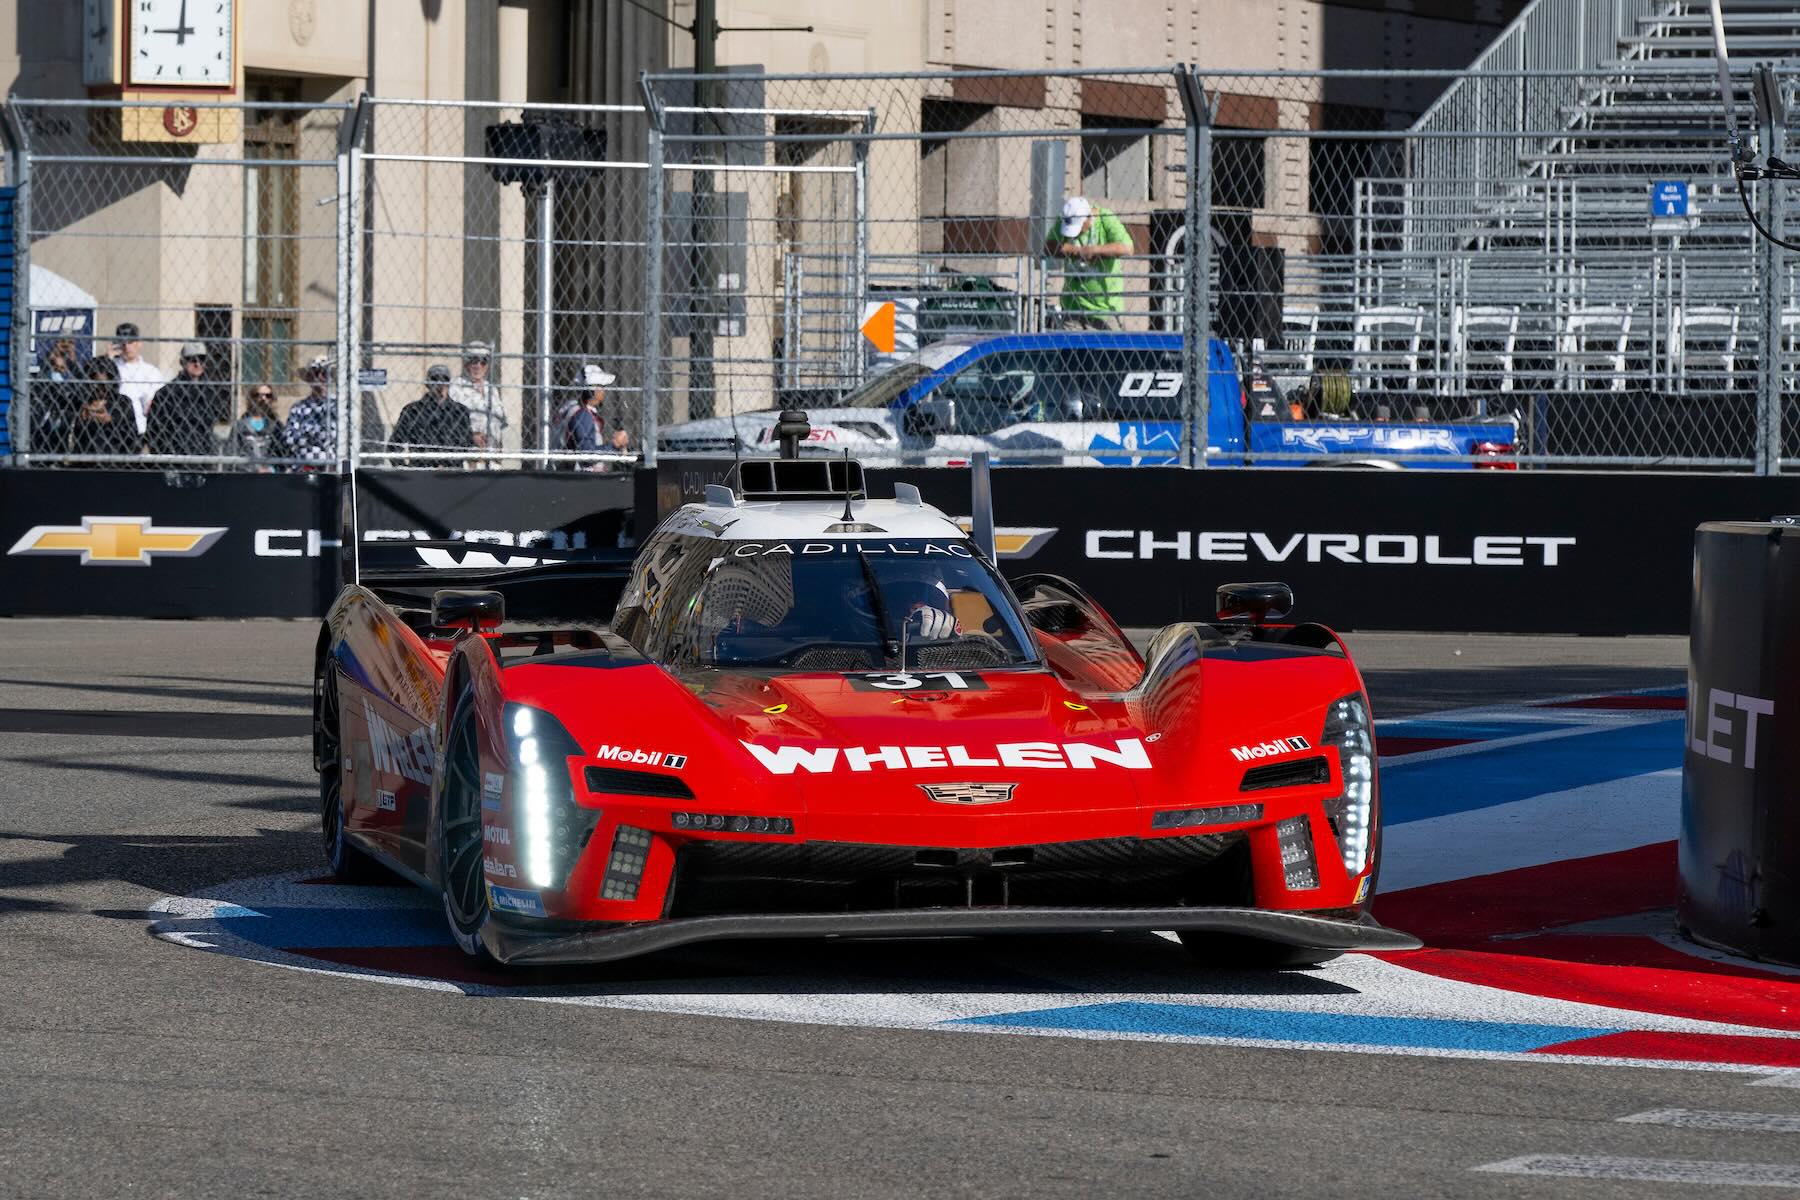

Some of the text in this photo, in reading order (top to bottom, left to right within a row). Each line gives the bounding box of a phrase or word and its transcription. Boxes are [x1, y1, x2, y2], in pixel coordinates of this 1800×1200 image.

[1666, 201, 1675, 215] A
[1118, 372, 1184, 398] 03
[1282, 427, 1461, 455] RAPTOR
[734, 542, 973, 558] CADILLAC
[1085, 529, 1577, 566] CHEVROLET
[865, 671, 969, 690] 31
[596, 744, 663, 766] Mobil
[738, 738, 1153, 775] WHELEN
[1230, 738, 1291, 761] Mobil
[484, 825, 511, 845] MOTUL
